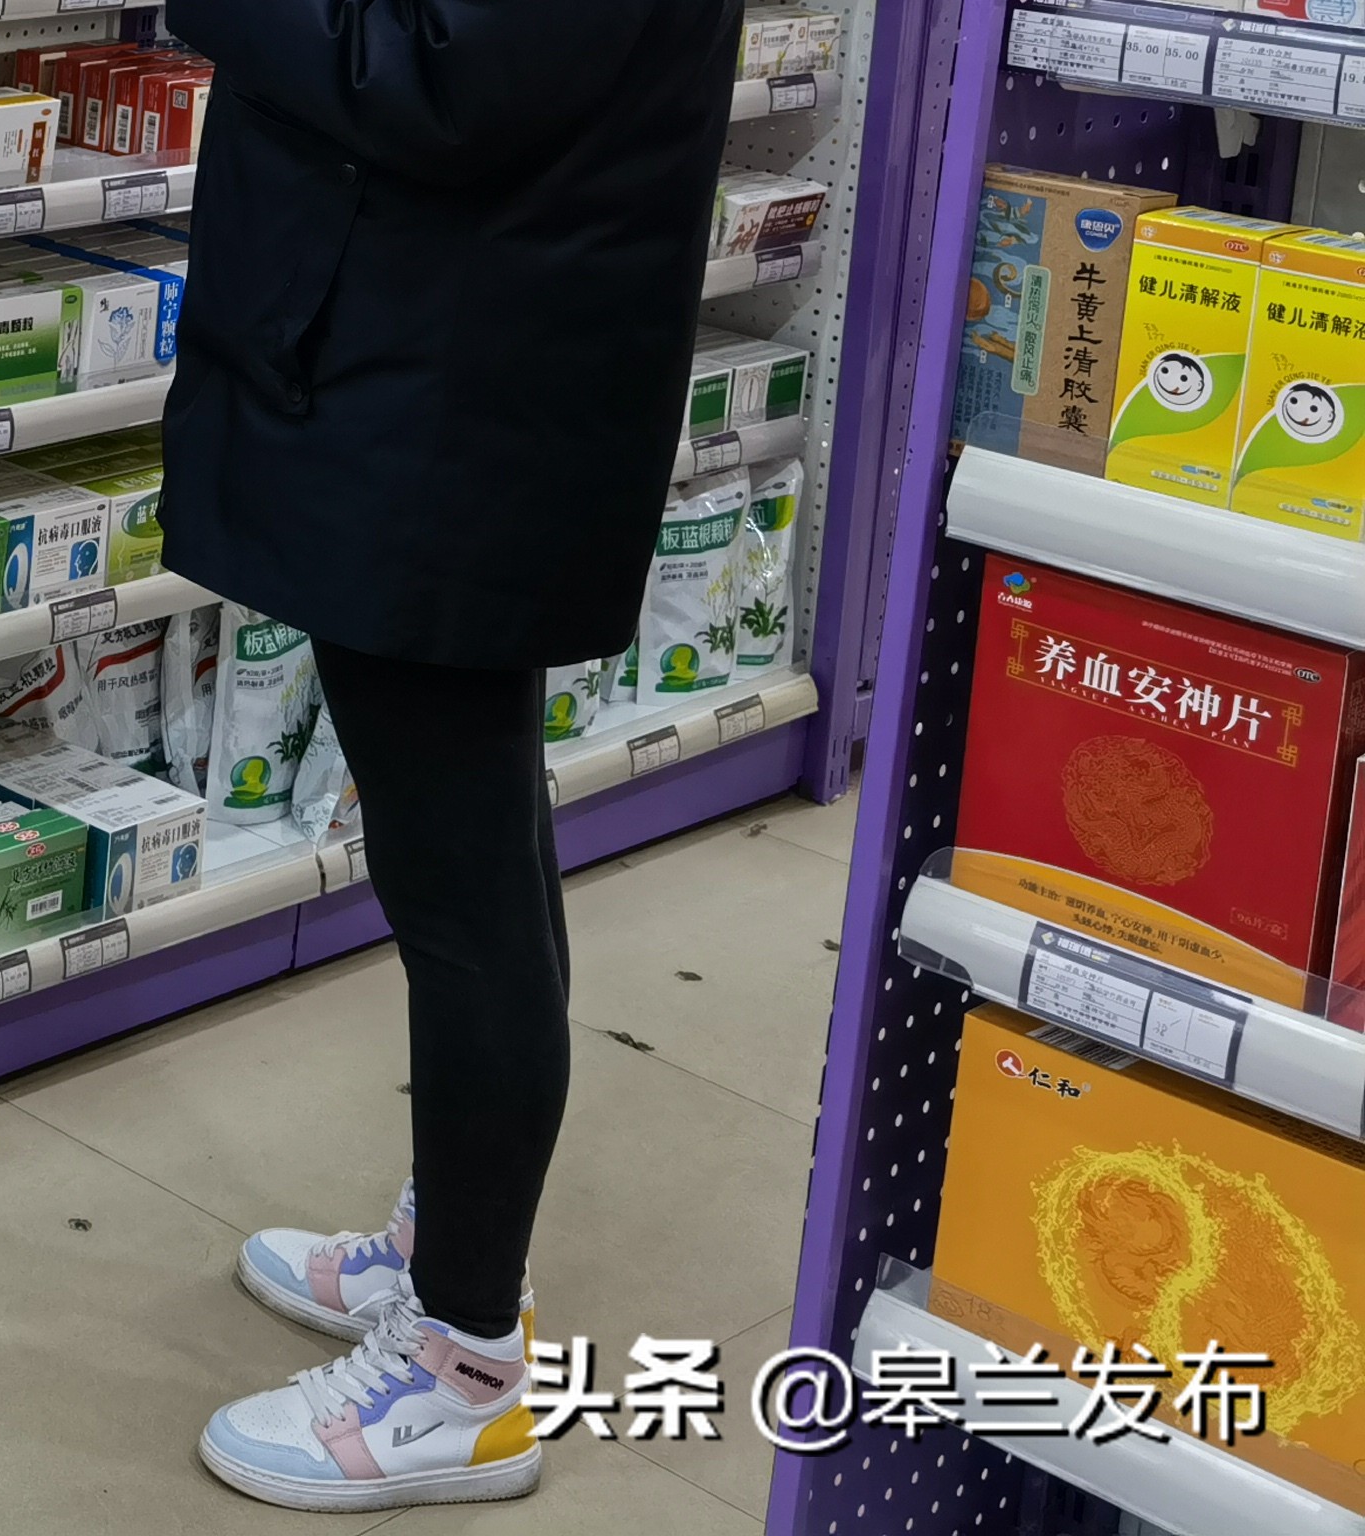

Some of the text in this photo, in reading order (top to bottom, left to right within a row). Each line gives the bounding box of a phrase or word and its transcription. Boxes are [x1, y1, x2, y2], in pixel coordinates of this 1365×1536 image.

[1126, 39, 1160, 56] 35.00
[1165, 46, 1200, 62] 35.00
[1080, 219, 1117, 235] 康恩贝
[1225, 240, 1251, 253] OTC
[1138, 273, 1242, 314] 健儿清解液
[159, 281, 180, 358] 肺宁颗粒
[1058, 261, 1107, 437] 牛黄上清胶囊
[38, 515, 103, 546] 抗病毒口服液
[659, 514, 736, 552] 板蓝根颗粒
[1033, 633, 1273, 742] 养血安神片
[1296, 667, 1319, 682] OTC
[1039, 675, 1253, 750] YANGXUE ANSHEN PIAN
[1027, 1066, 1081, 1099] 仁和
[454, 1361, 505, 1391] WARRIOR
